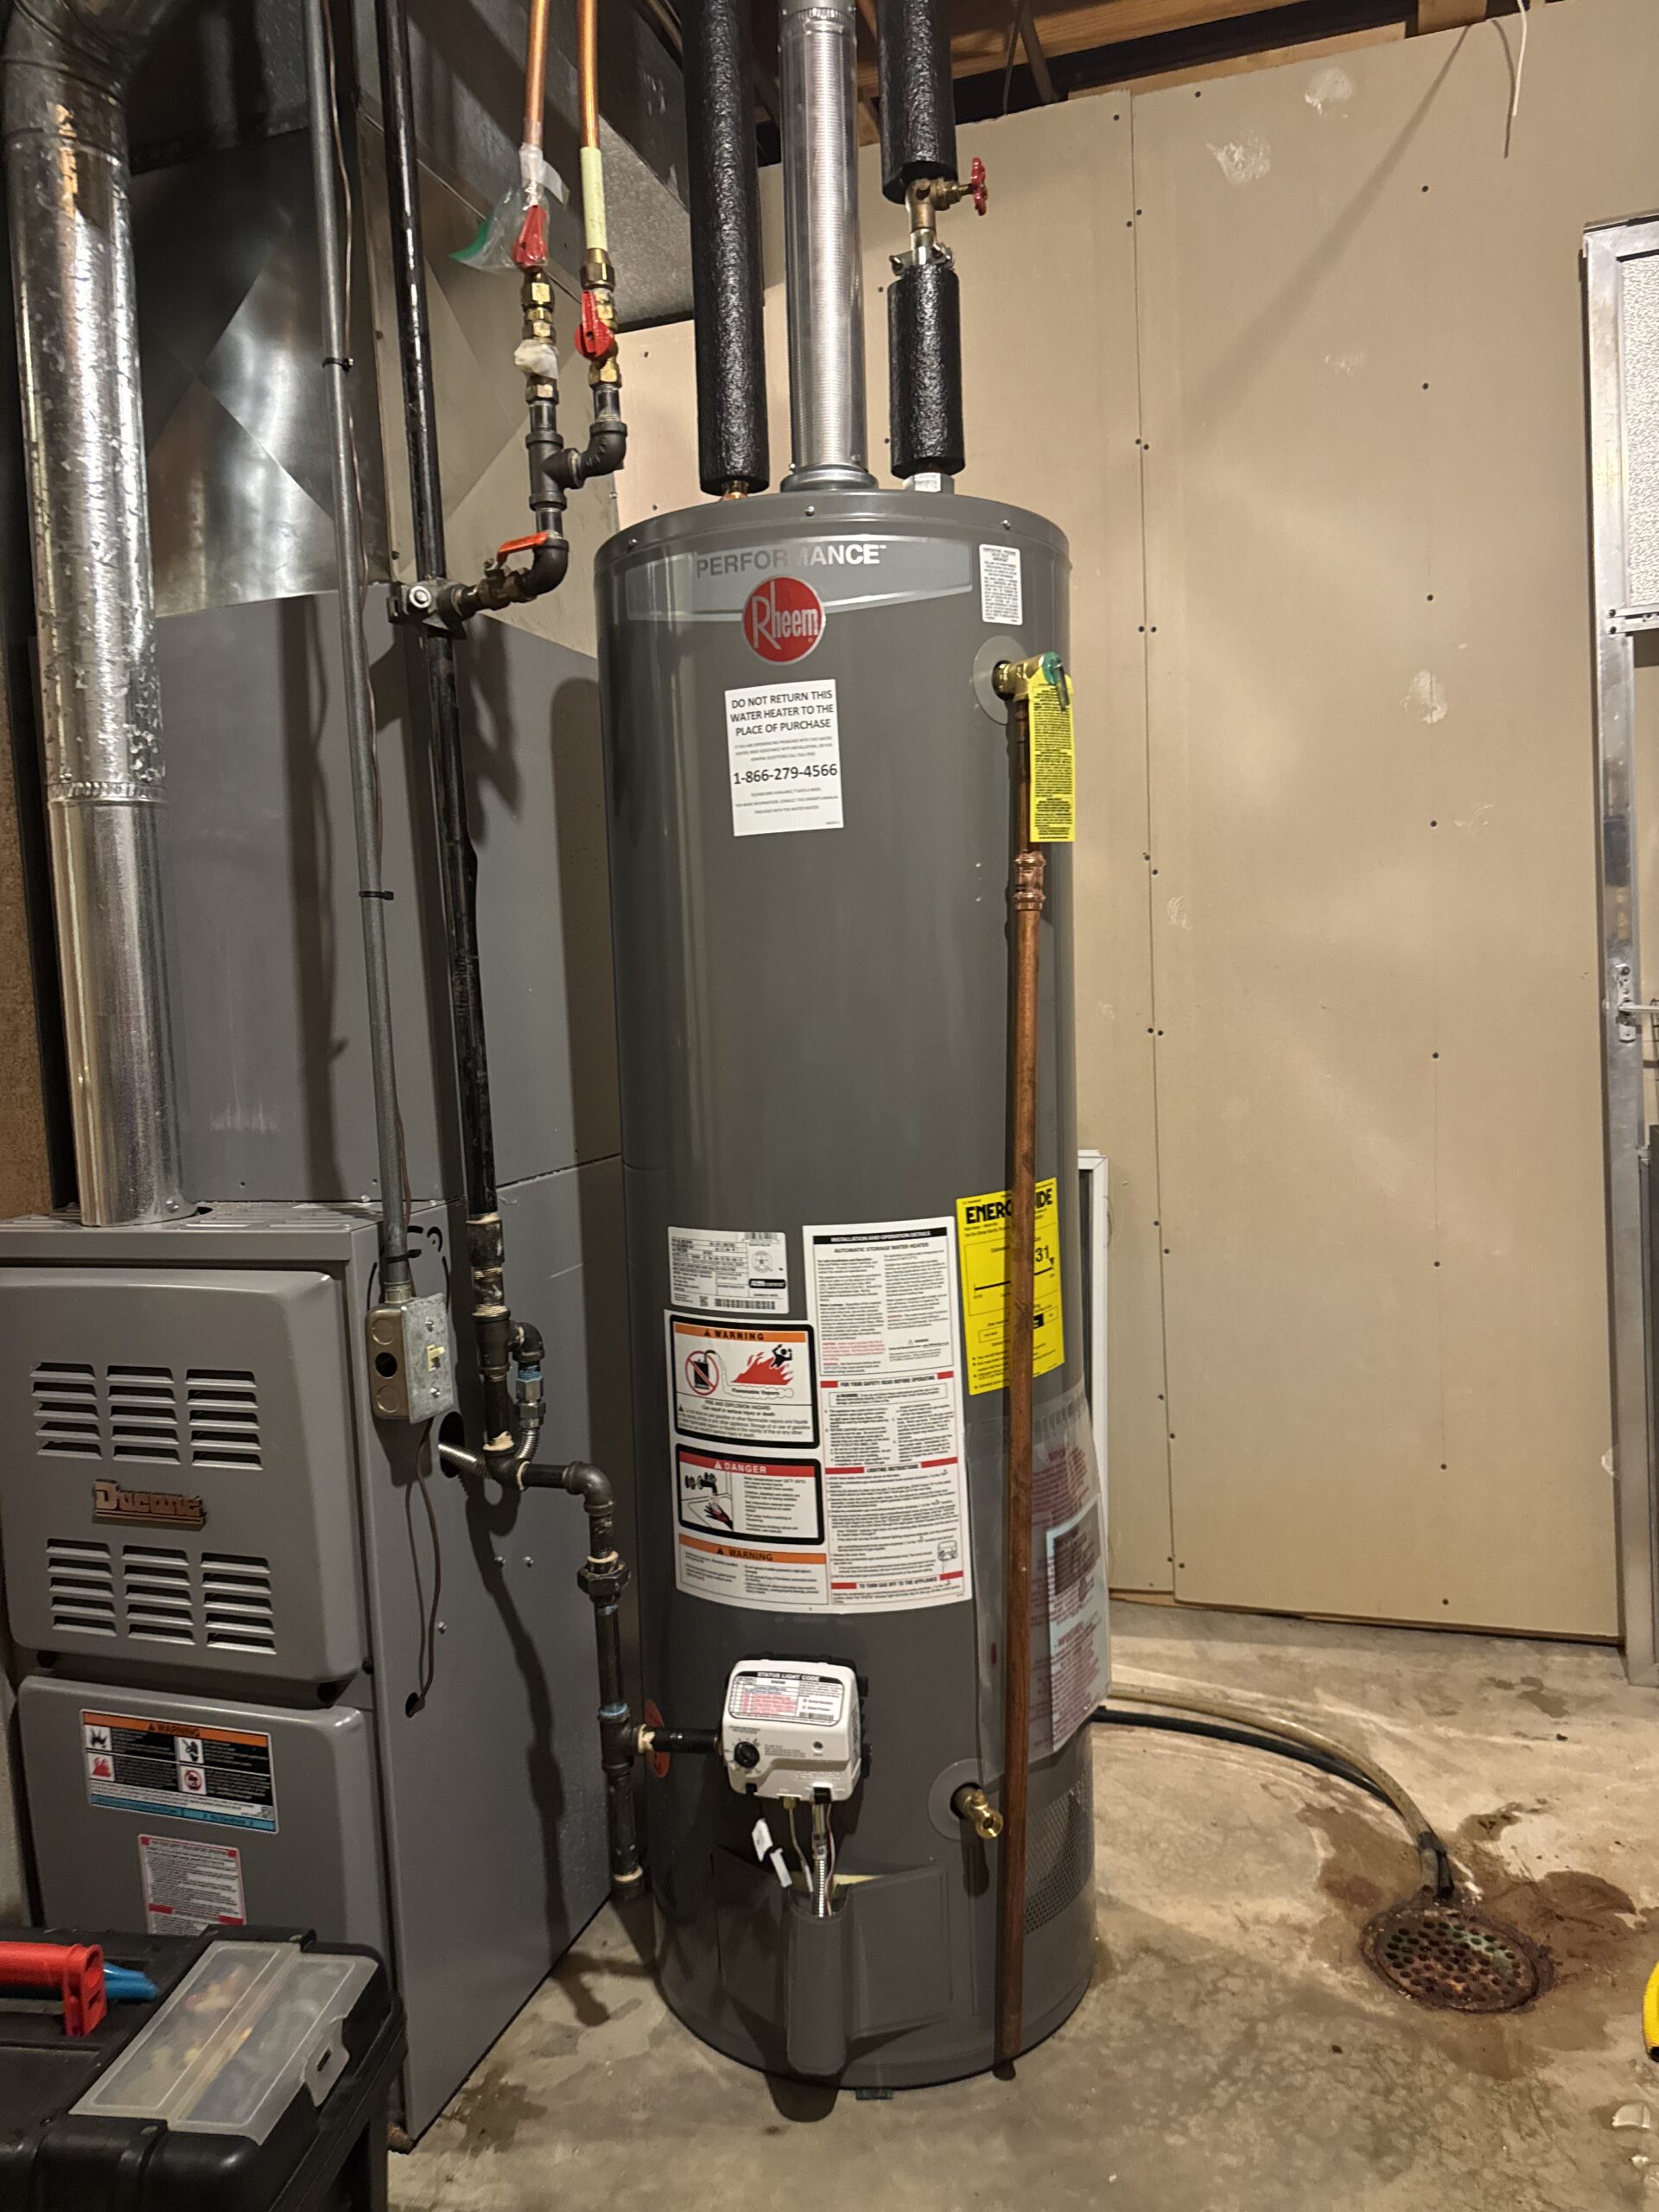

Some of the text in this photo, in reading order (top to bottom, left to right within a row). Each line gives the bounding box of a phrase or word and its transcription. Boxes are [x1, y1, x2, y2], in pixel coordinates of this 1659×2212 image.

[752, 581, 818, 650] Rheem
[732, 690, 833, 709] DO NOT RETURN THIS
[730, 704, 834, 722] WATER HEATER TO THE
[735, 719, 831, 736] PLACE OF PURCHASE
[733, 764, 838, 785] 1-866-279-4566
[714, 1330, 765, 1340] WARNING
[724, 1463, 767, 1474] DANGER
[728, 1548, 773, 1561] WARNING
